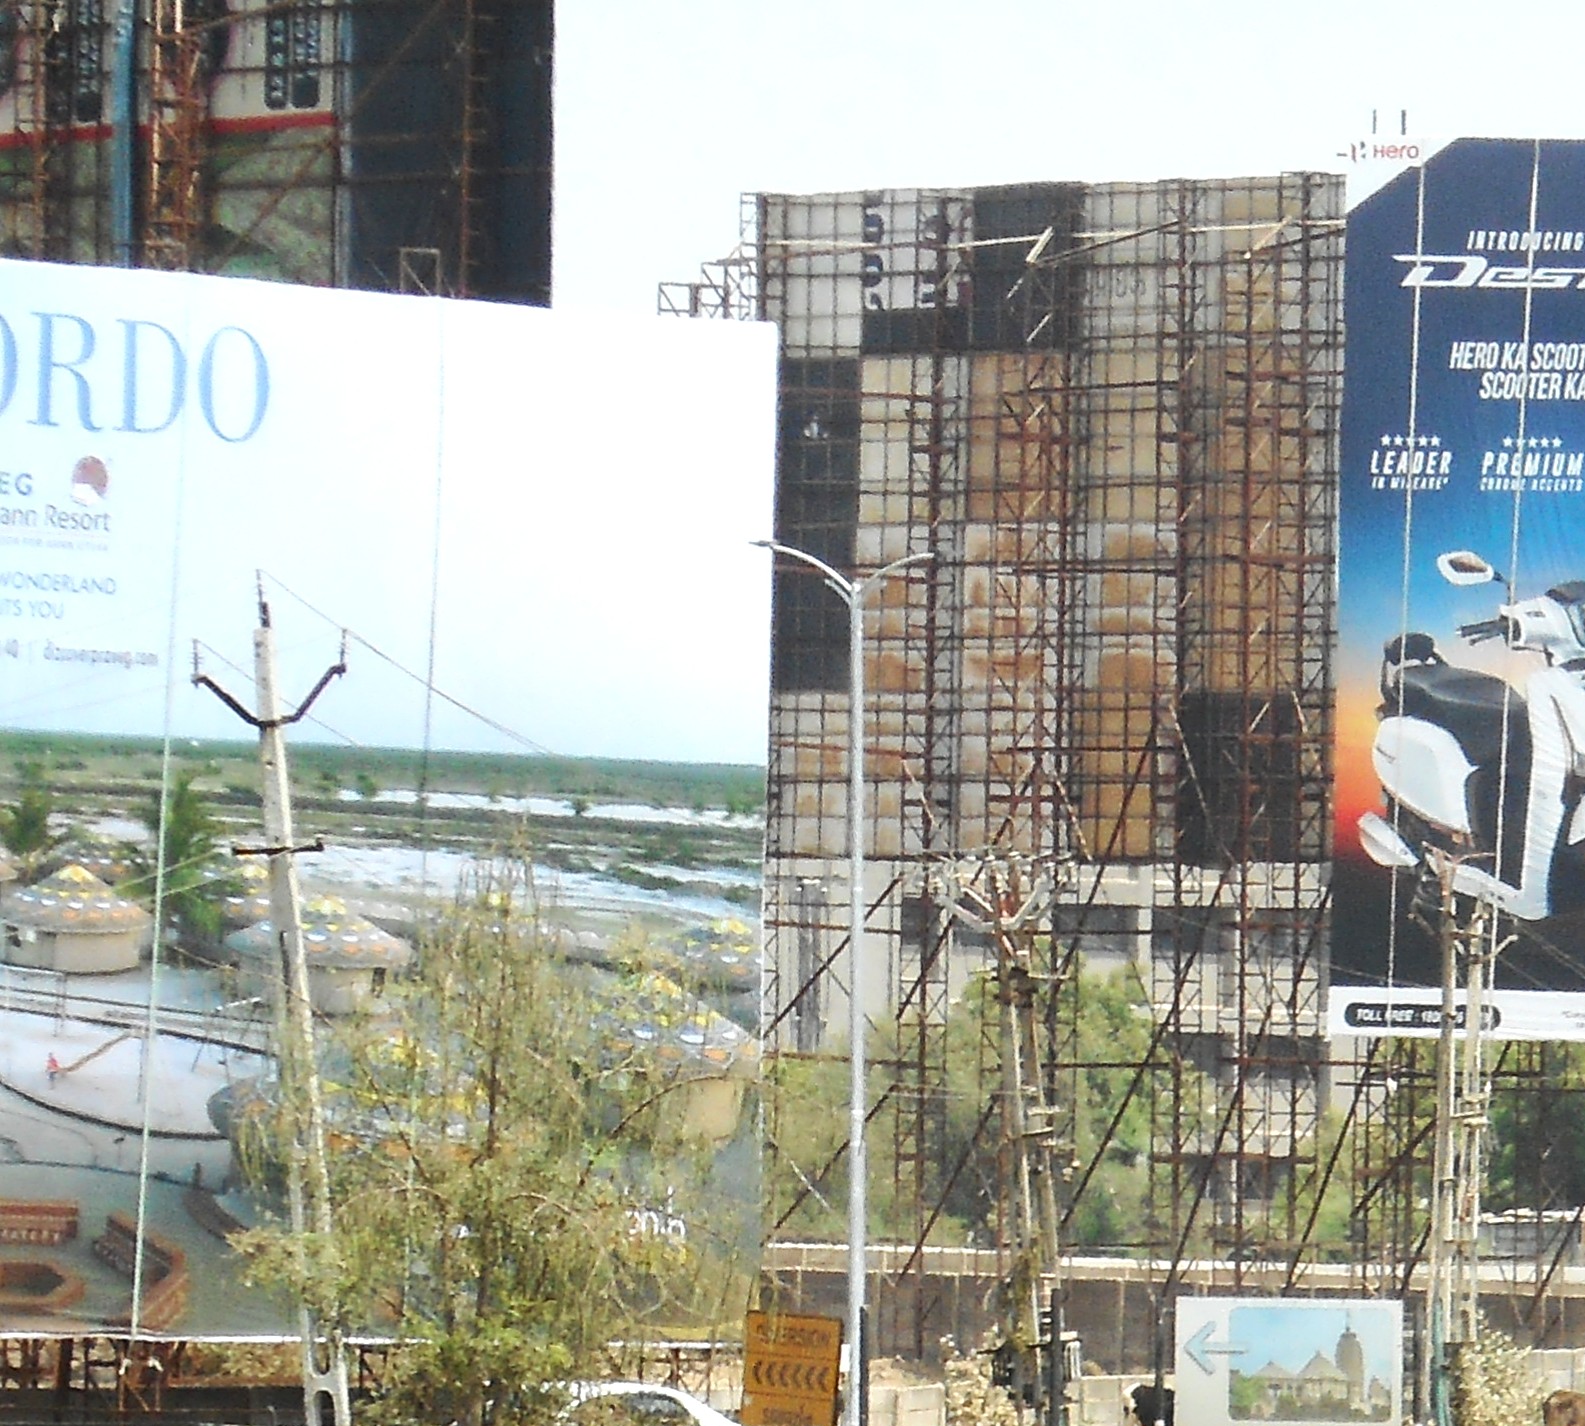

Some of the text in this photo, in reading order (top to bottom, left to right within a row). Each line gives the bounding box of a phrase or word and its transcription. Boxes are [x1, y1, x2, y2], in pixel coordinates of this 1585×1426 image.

[1373, 144, 1420, 159] Hero
[1467, 230, 1584, 251] INTRODUCING
[1449, 341, 1499, 370] HERO
[1501, 342, 1528, 370] KA
[1479, 372, 1563, 400] SCOOTER
[1370, 450, 1453, 476] LEADER
[1480, 452, 1585, 477] PREMIUM
[44, 503, 112, 532] Resort
[28, 599, 65, 620] YOU
